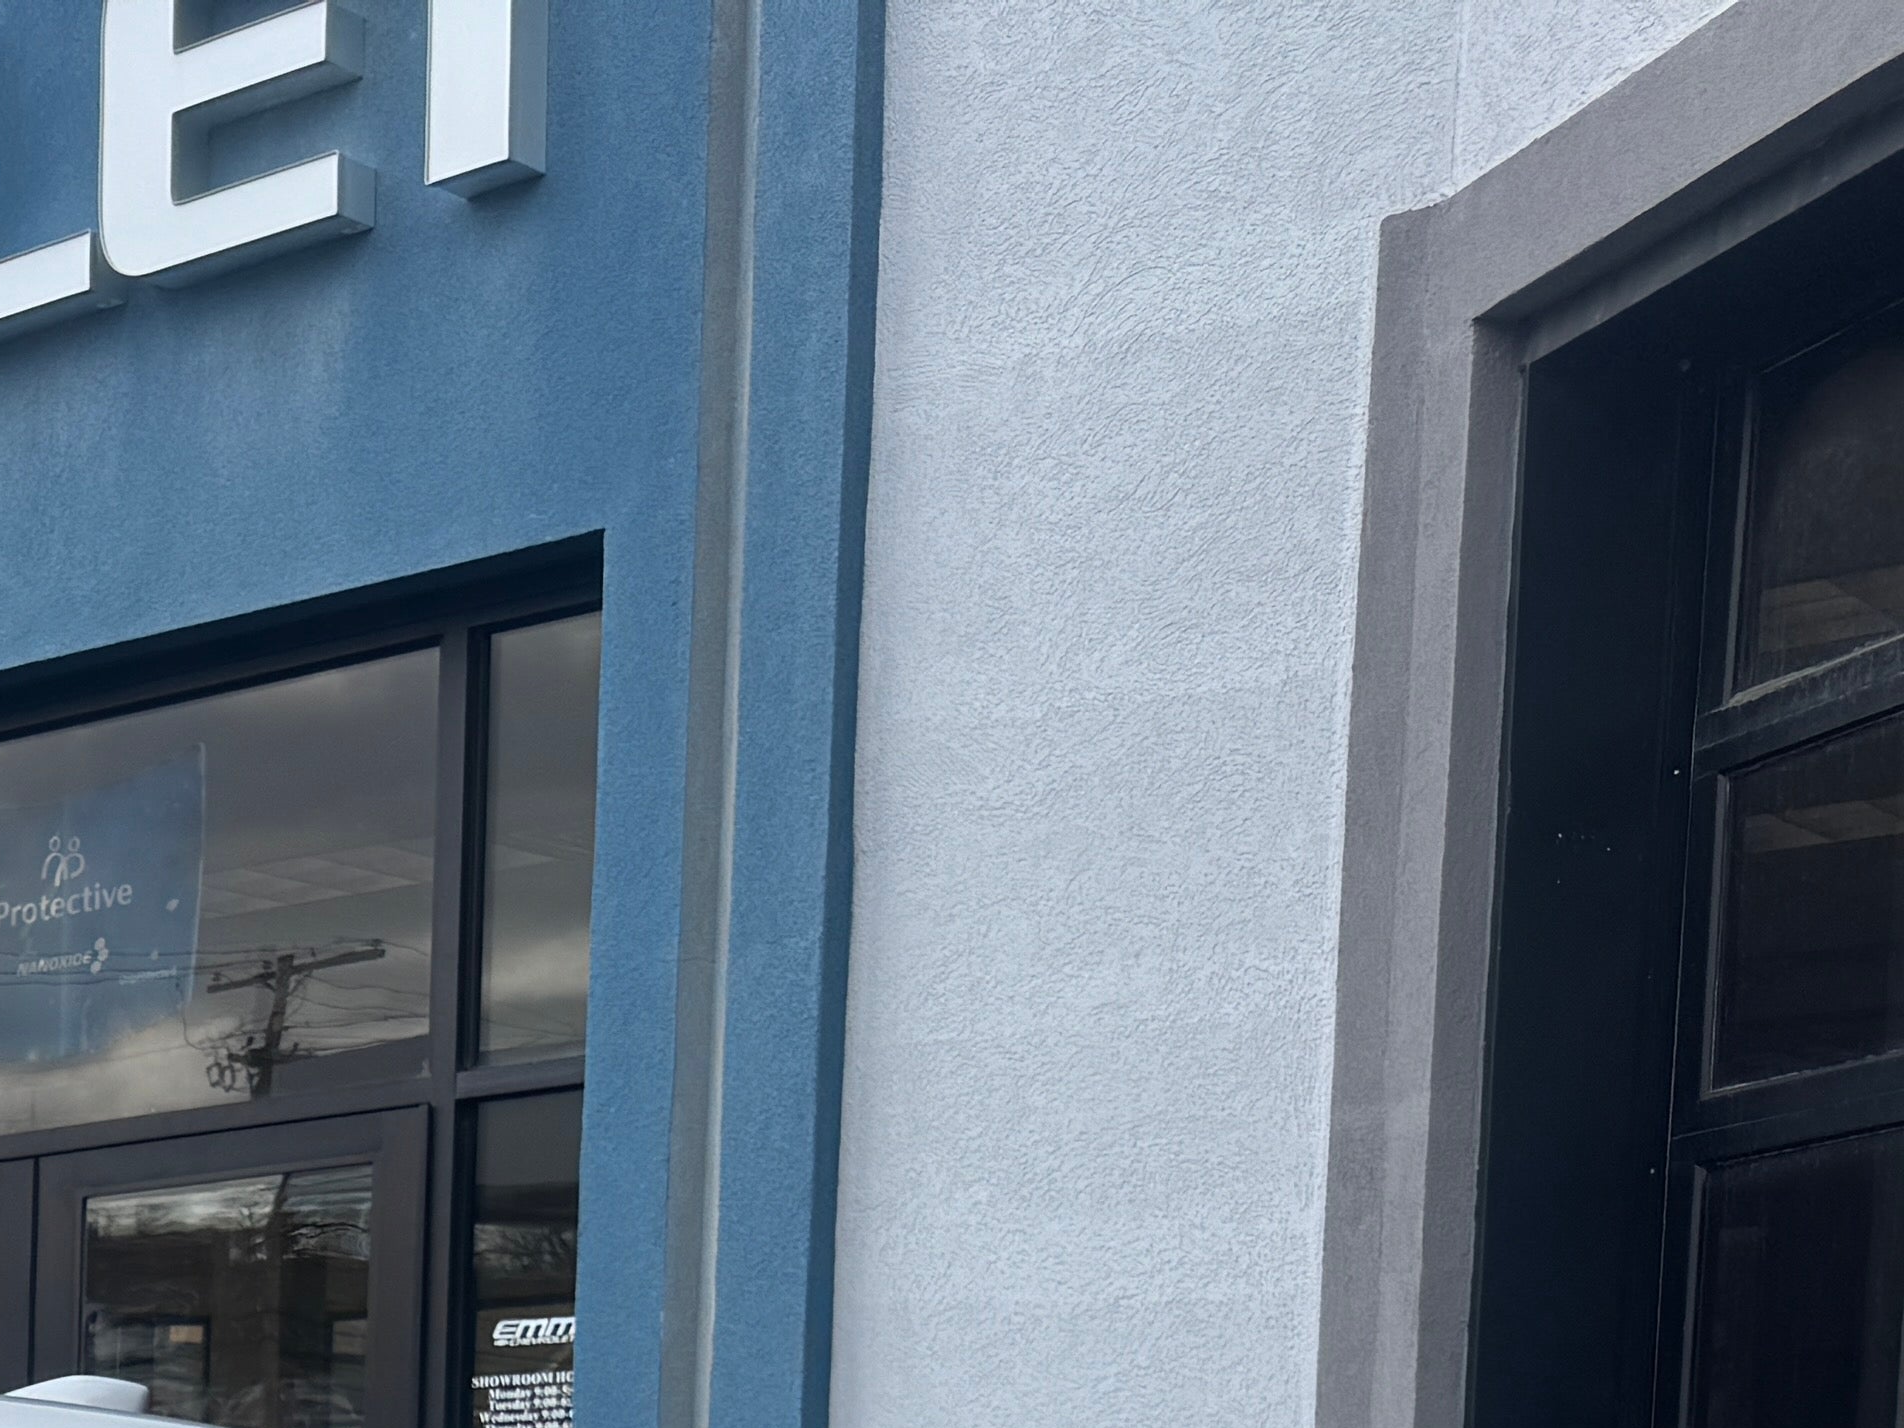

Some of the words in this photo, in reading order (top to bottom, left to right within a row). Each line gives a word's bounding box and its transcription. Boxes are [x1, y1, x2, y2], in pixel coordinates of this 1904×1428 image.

[471, 1372, 553, 1389] SHOWROOM
[488, 1386, 533, 1400] Monday
[489, 1398, 532, 1412] Tuesday
[479, 1410, 539, 1424] Wednesday
